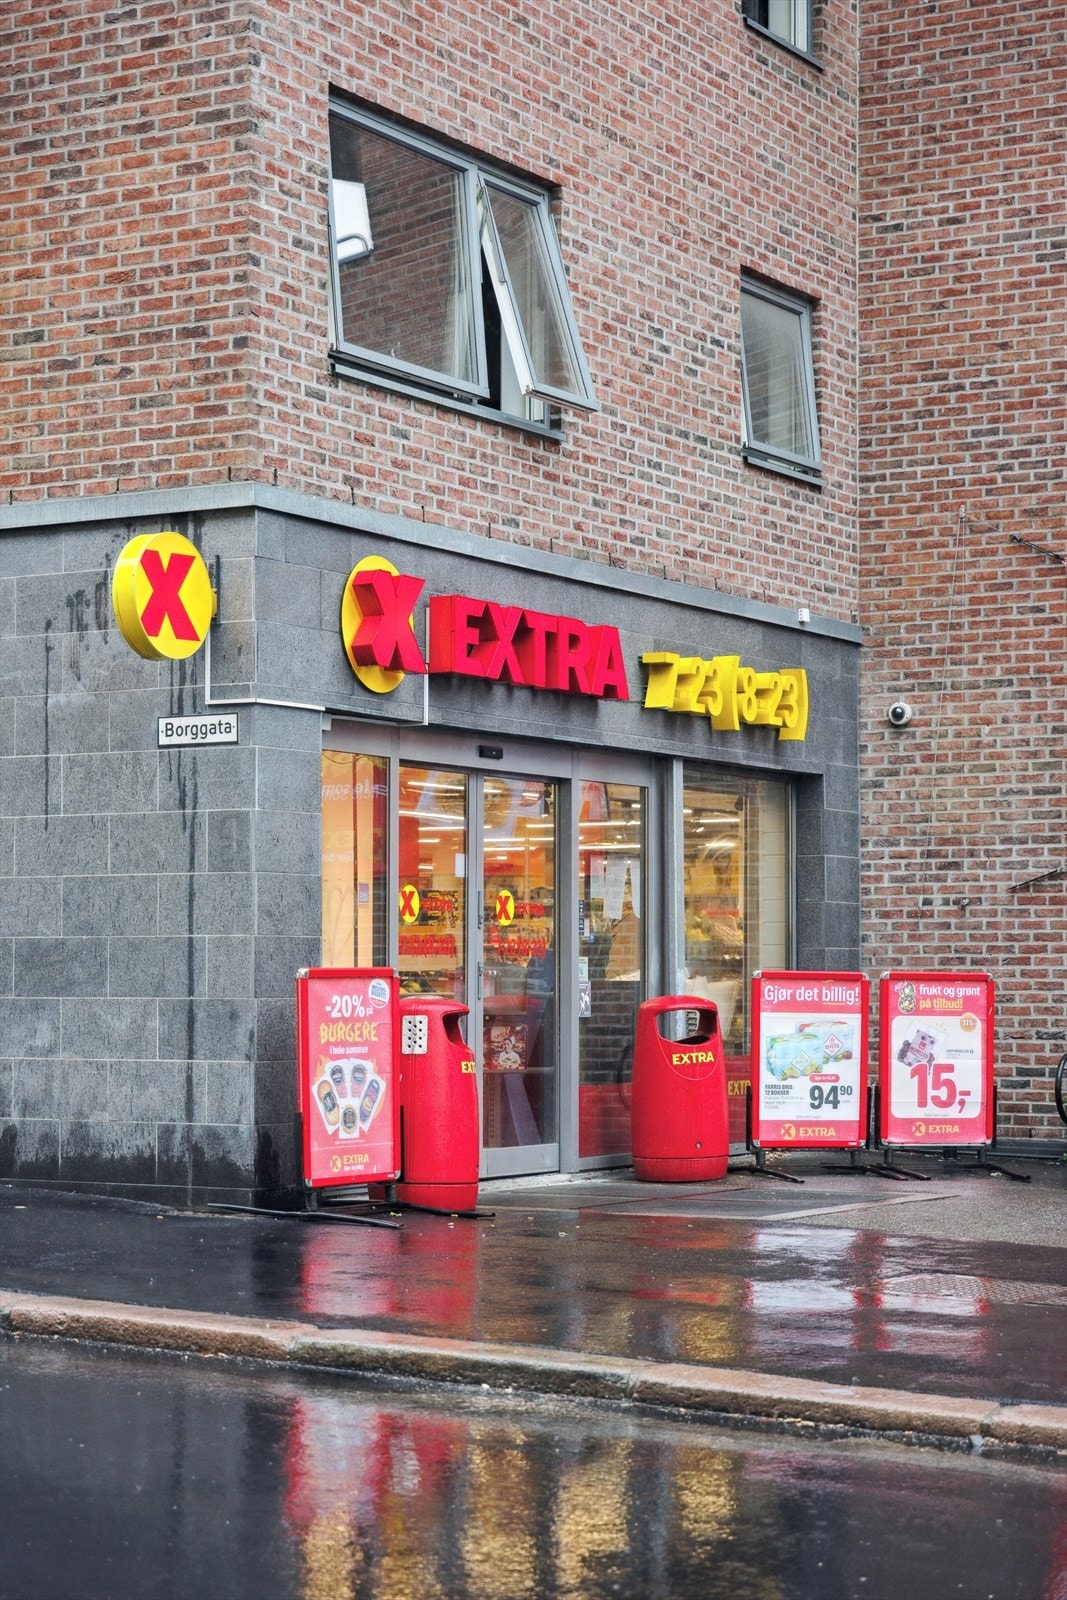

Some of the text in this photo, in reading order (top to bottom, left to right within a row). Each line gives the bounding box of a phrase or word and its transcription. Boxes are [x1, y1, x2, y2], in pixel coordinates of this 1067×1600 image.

[140, 548, 201, 642] X
[351, 569, 630, 701] X EXTRA
[164, 720, 232, 740] Borggata
[514, 902, 545, 916] EXTRA
[764, 985, 859, 1005] Gjør det billig!
[919, 984, 941, 995] frukt
[943, 987, 955, 997] og
[956, 986, 981, 997] grønt
[325, 994, 365, 1018] -20%
[919, 998, 963, 1010] på tilbud!
[319, 1020, 378, 1044] BURGERE
[672, 1051, 715, 1065] EXTRA
[799, 1127, 836, 1137] EXTRA
[928, 1125, 960, 1134] EXTRA
[343, 1153, 370, 1165] EXTRA
